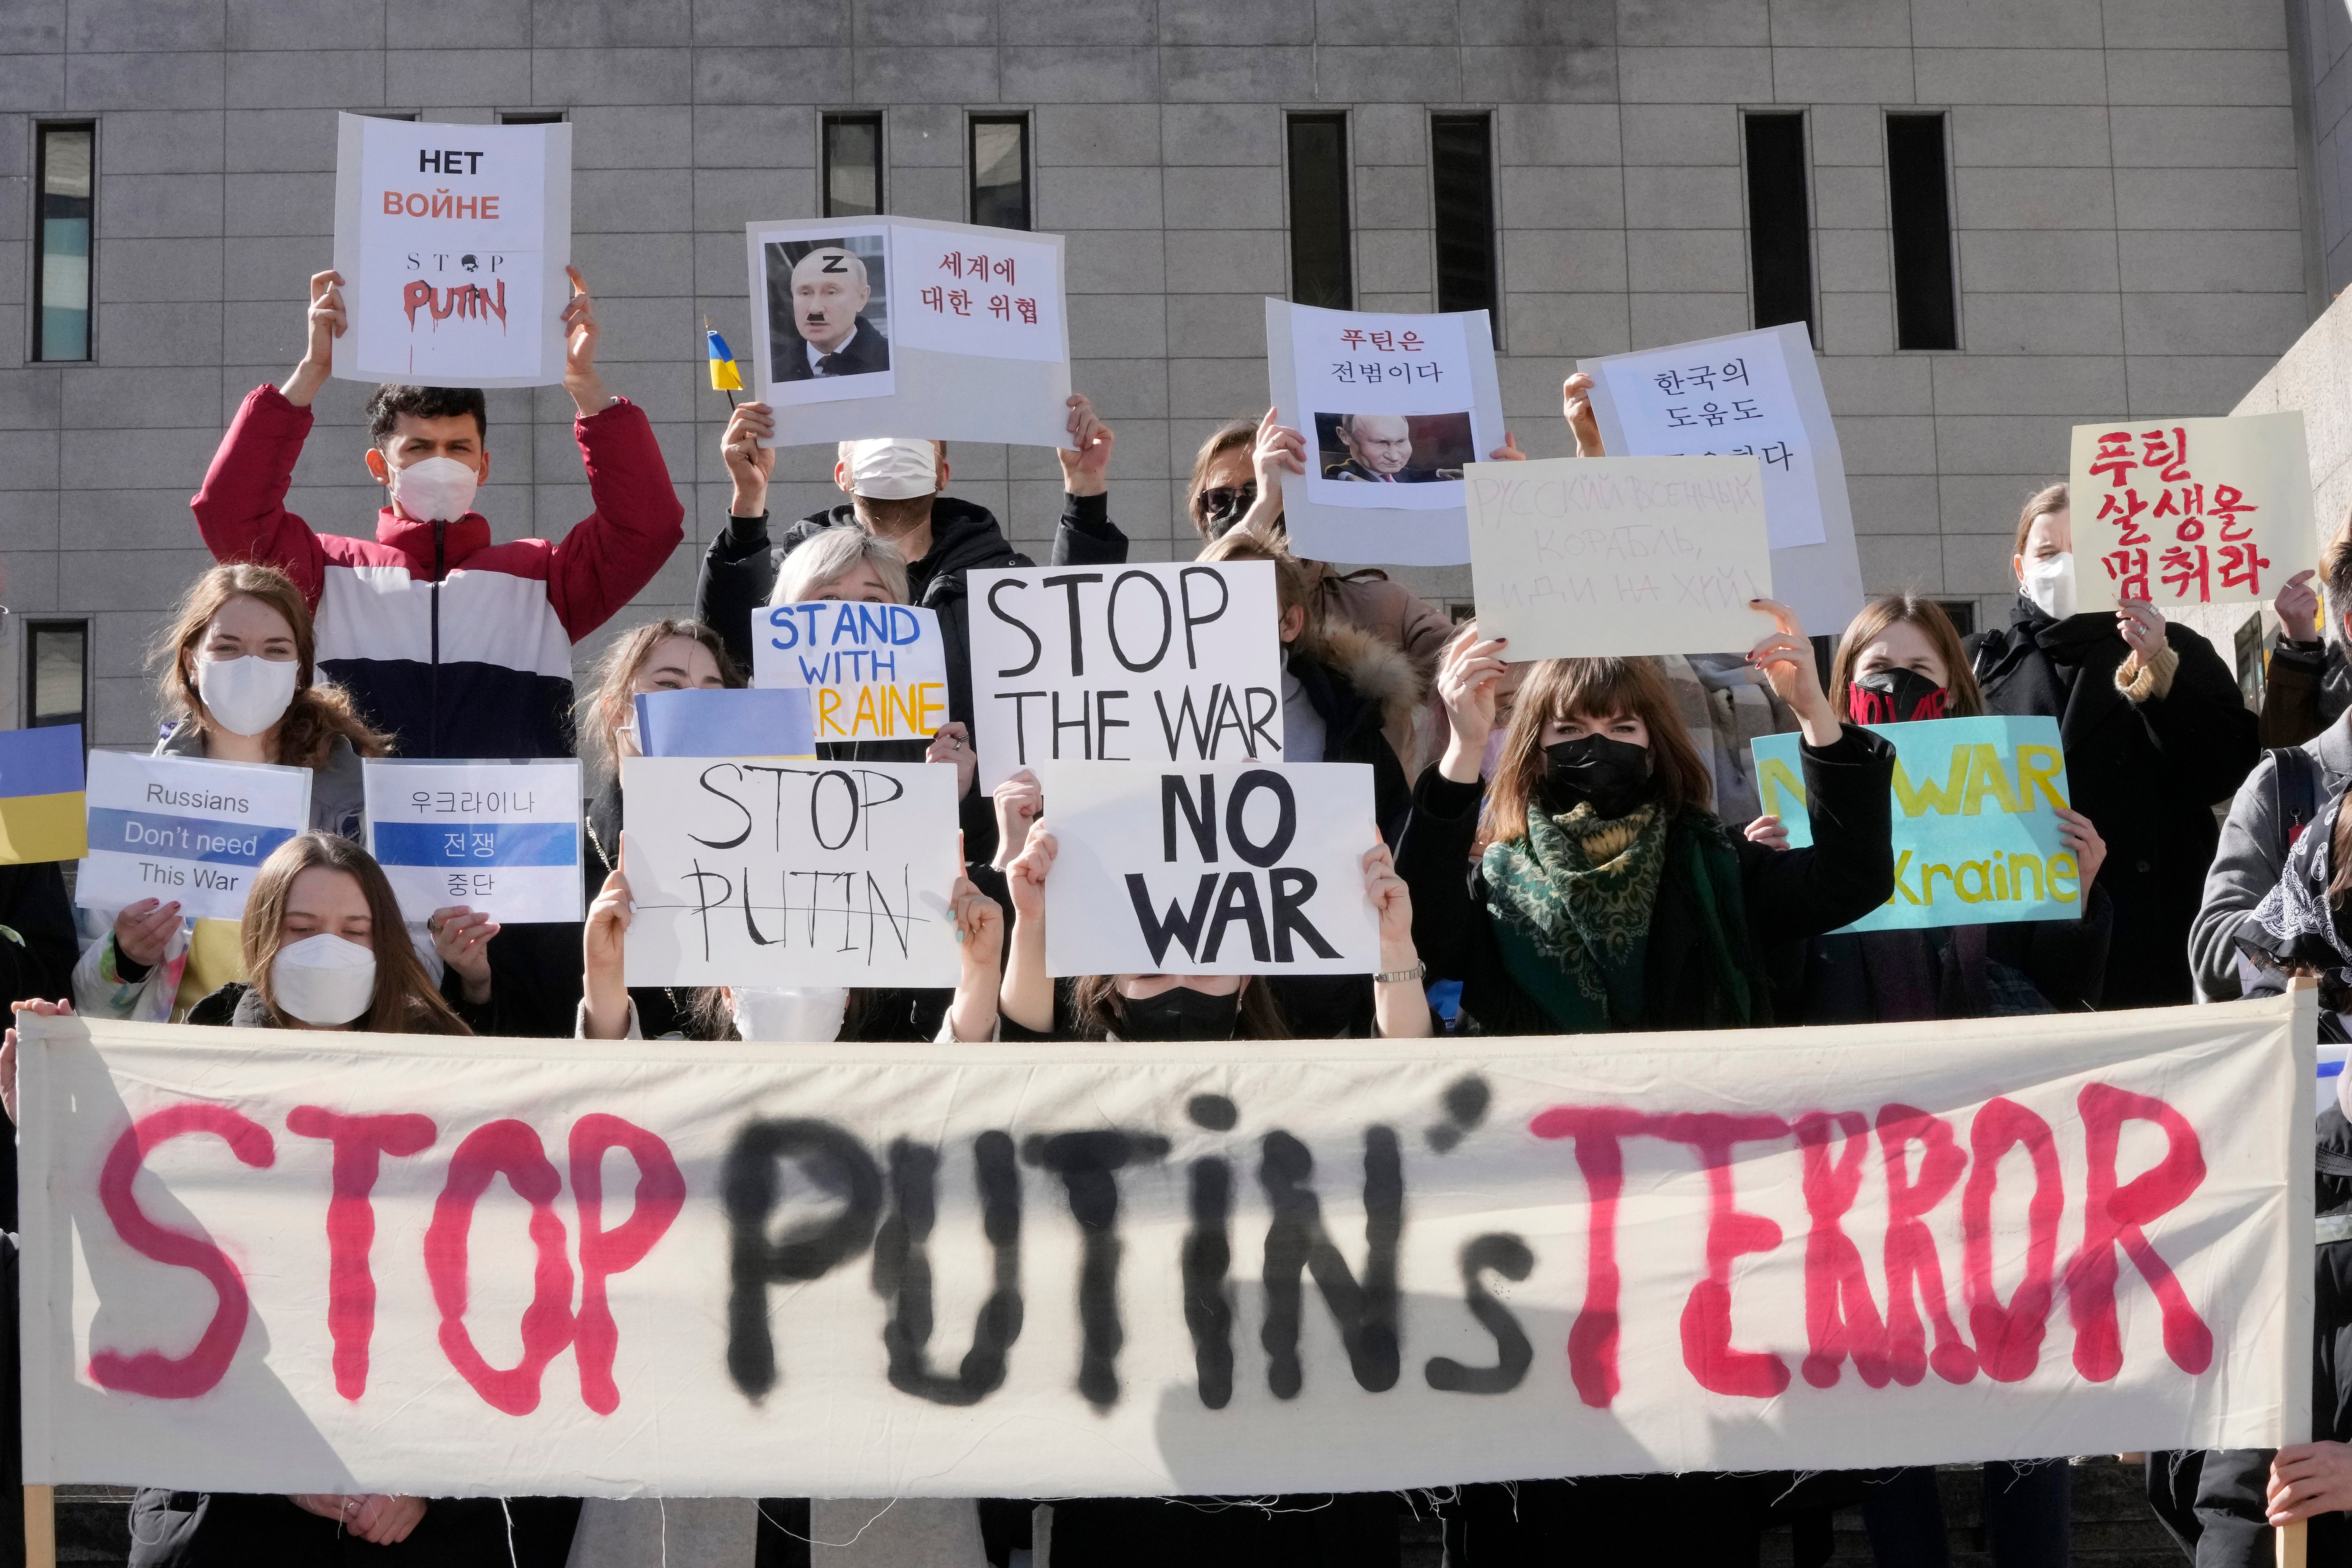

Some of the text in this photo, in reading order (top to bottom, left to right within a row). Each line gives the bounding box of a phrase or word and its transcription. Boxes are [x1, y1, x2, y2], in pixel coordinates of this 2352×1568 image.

[419, 149, 483, 174] НЕТ
[384, 189, 499, 219] ВОЙНЕ
[822, 256, 848, 273] Z
[939, 251, 1015, 286] 세계에
[404, 279, 506, 337] PUTIN
[920, 286, 1038, 324] 대한 위협
[1340, 329, 1425, 352] 푸틴은
[1332, 361, 1443, 384] 전범이다
[1653, 358, 1749, 395] 한국의
[1666, 399, 1764, 428] 도움도
[2089, 427, 2191, 487] 푸틴
[2096, 483, 2259, 546] 살생을
[770, 603, 920, 650] STAND
[987, 567, 1229, 678] STOP
[799, 650, 895, 684] WITH
[813, 683, 945, 737] RAINE
[995, 683, 1283, 765] THE WAR
[147, 783, 249, 813] Russians
[1891, 743, 2070, 818] WAR
[411, 791, 535, 814] 우크라이나
[688, 763, 904, 852] STOP
[1161, 769, 1296, 867] NO
[196, 835, 257, 856] need
[444, 833, 494, 858] 전쟁
[139, 862, 239, 891] This War
[448, 874, 494, 896] 중단
[681, 858, 908, 966] PUTIN
[1124, 867, 1345, 968] WAR
[87, 1102, 686, 1416] STOP
[1528, 1082, 2214, 1409] TERROR
